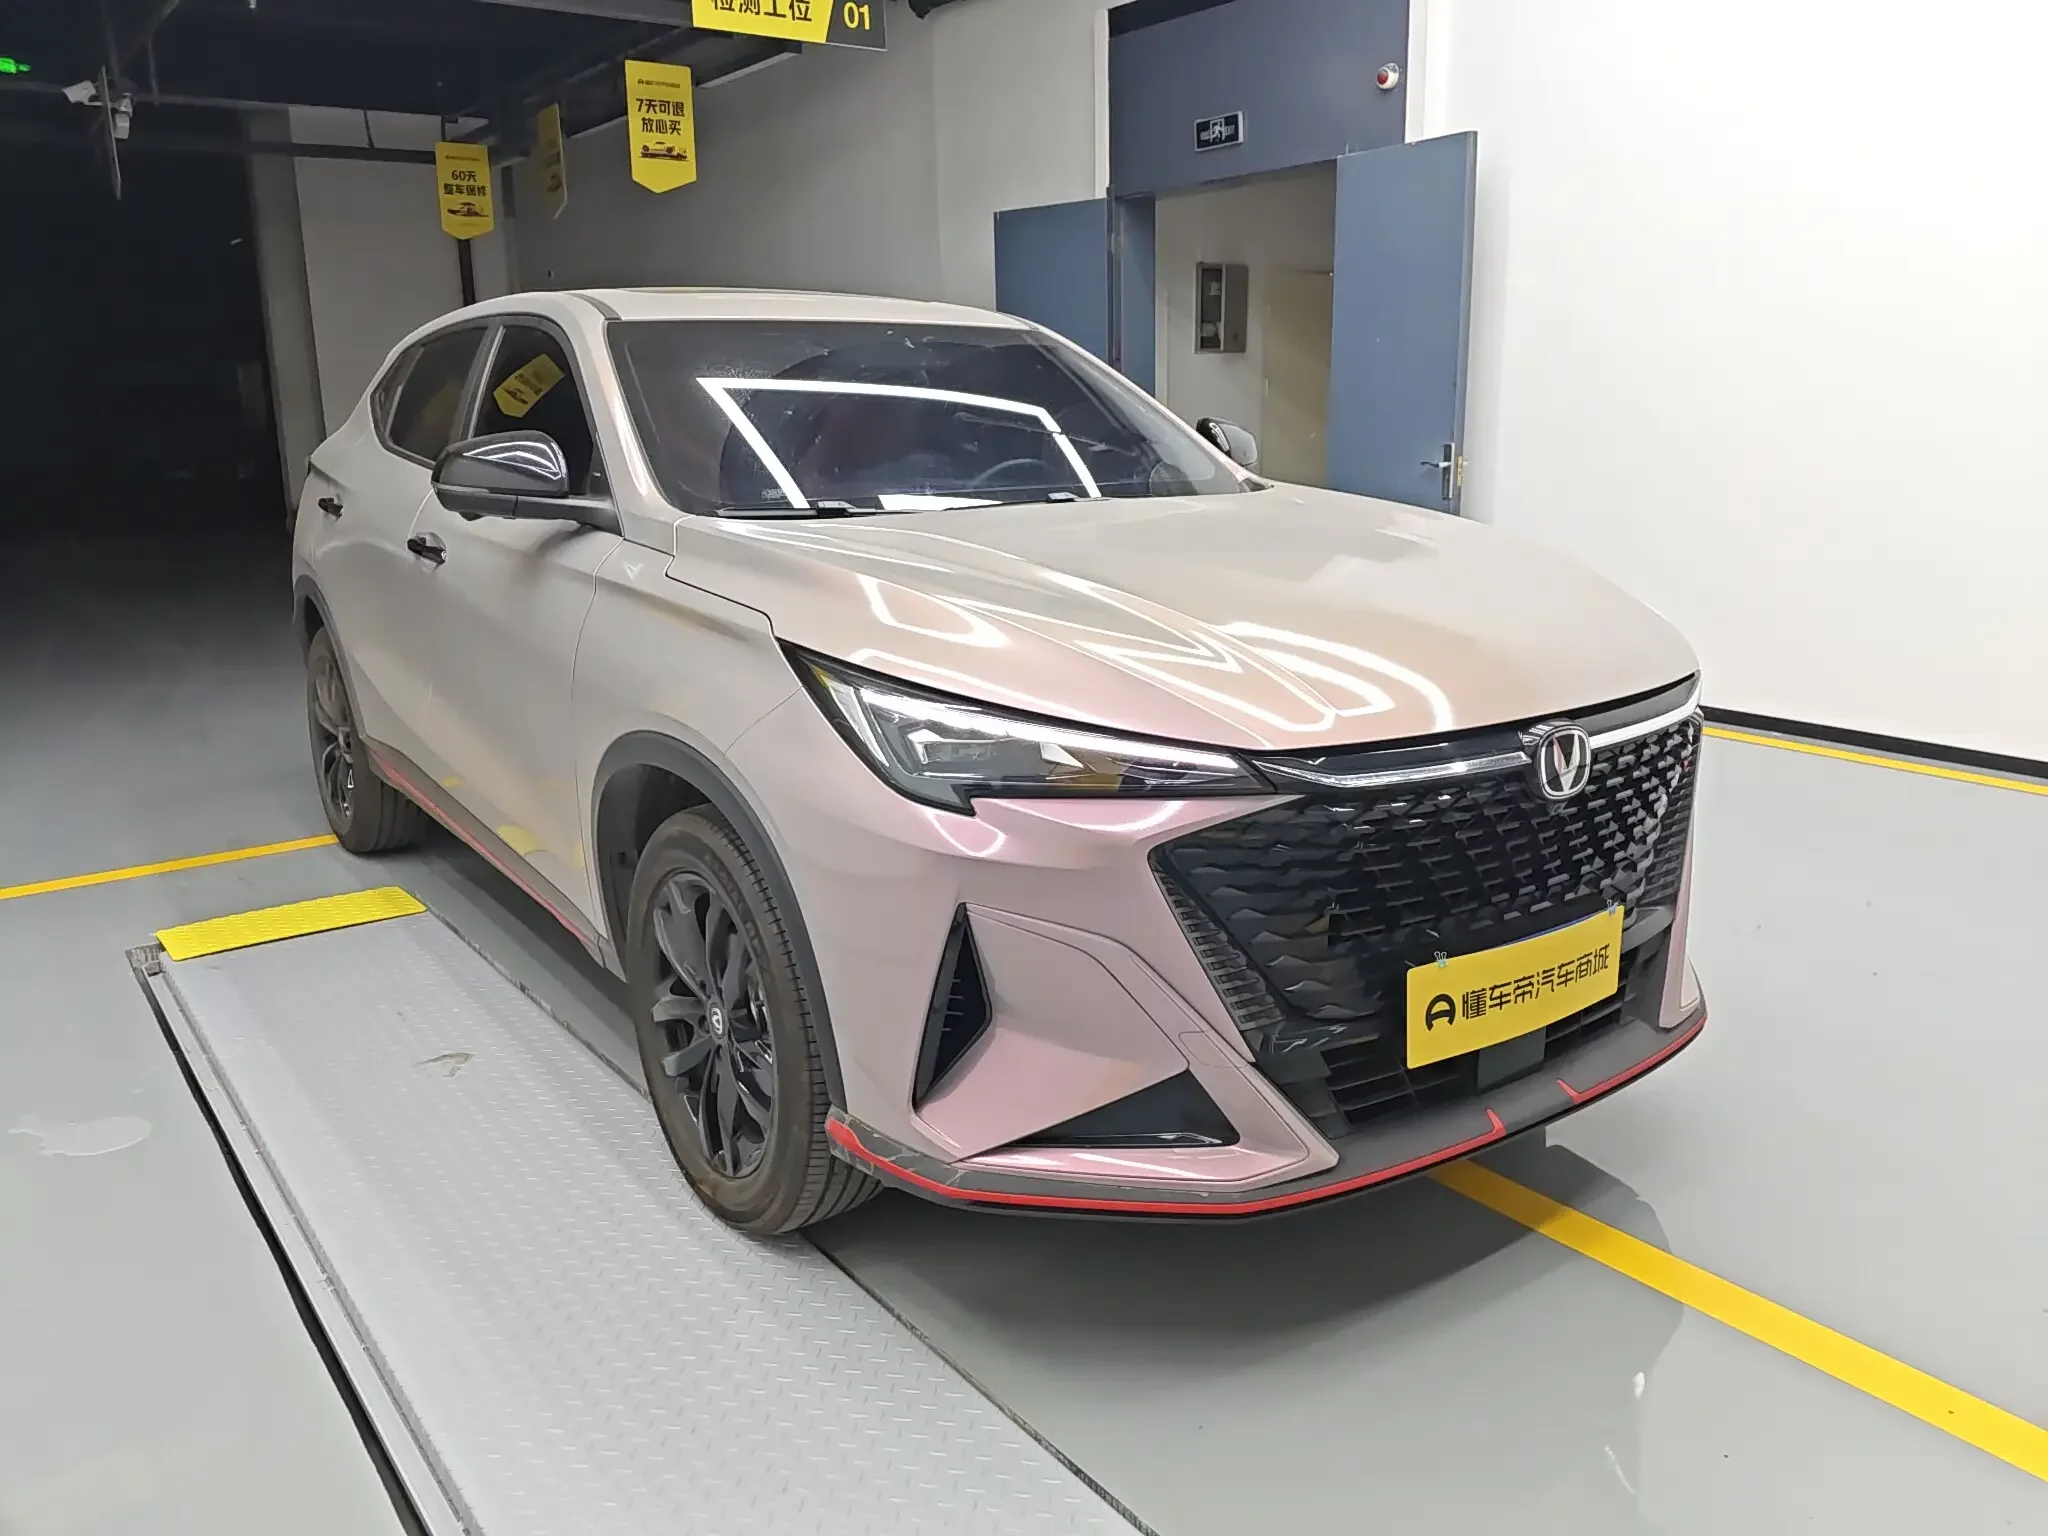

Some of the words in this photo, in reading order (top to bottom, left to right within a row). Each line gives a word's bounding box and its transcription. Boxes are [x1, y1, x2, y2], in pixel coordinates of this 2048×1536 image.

[843, 1, 871, 31] 01
[636, 98, 685, 118] 7天可退
[641, 117, 682, 136] 放心买
[451, 170, 477, 183] 60天
[1462, 943, 1611, 1020] 懂车帝汽车商城
